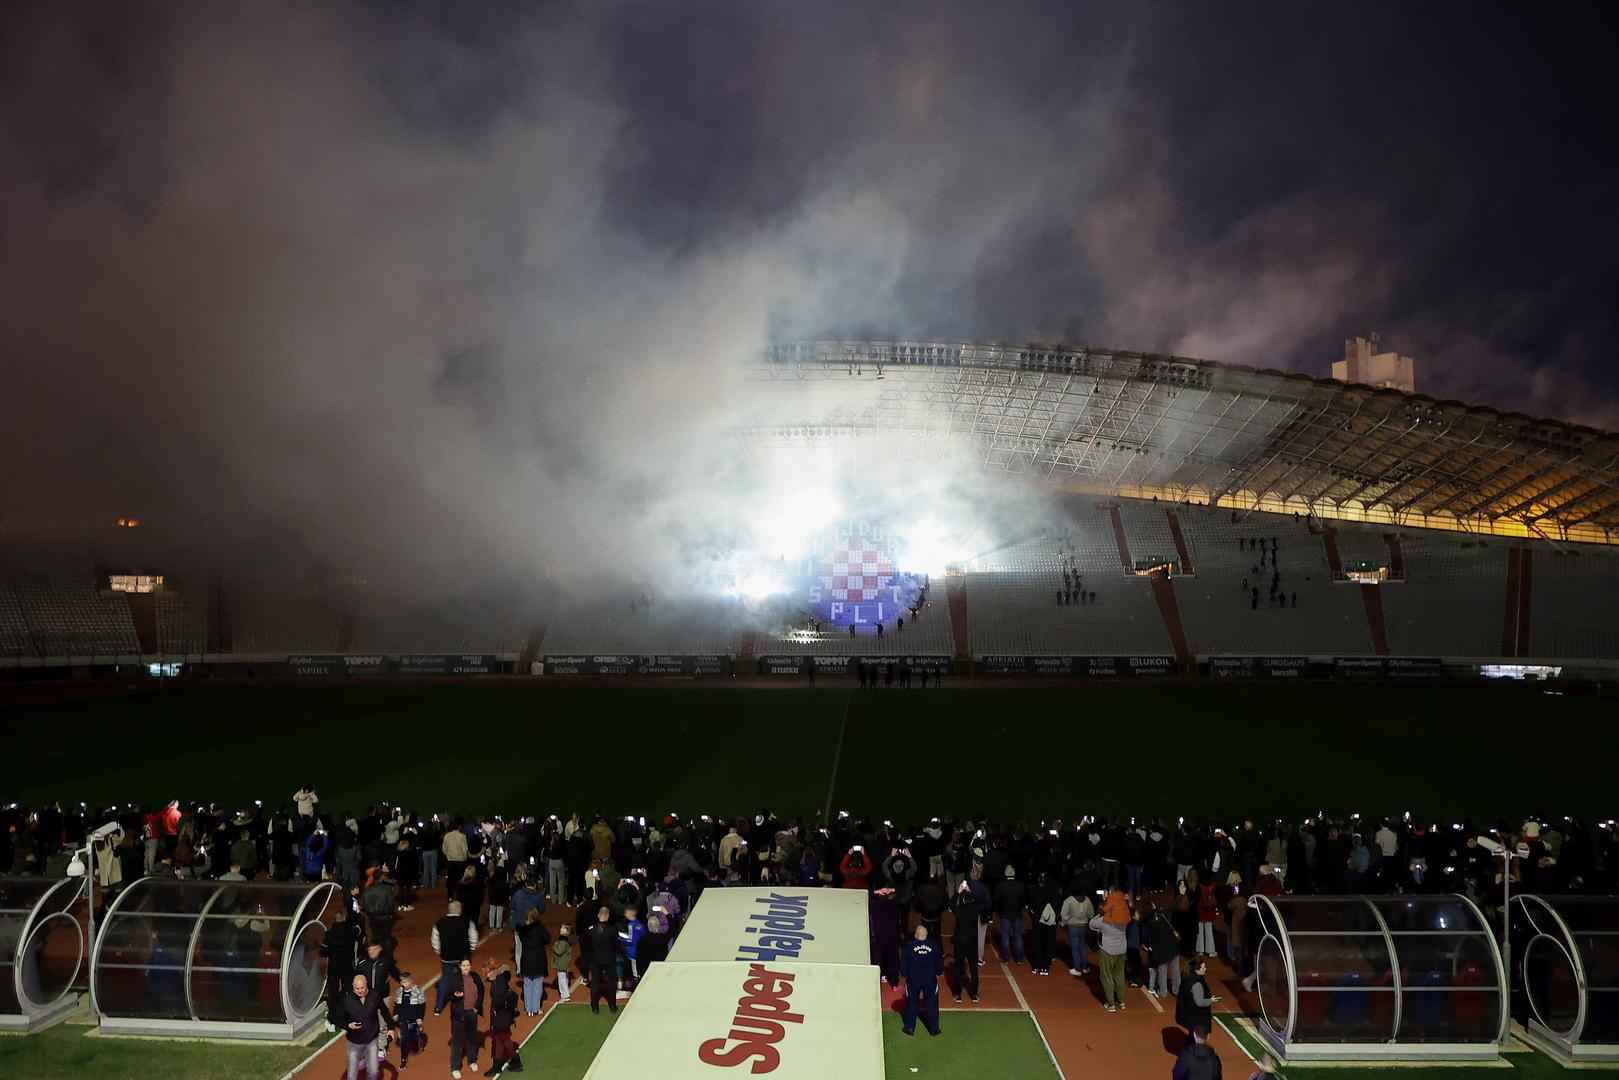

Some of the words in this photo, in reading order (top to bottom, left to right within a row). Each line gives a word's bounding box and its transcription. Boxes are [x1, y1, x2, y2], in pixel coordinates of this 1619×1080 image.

[809, 585, 901, 623] SPLIT
[344, 656, 383, 665] TOMMY
[813, 656, 850, 665] TOMMY
[1139, 658, 1170, 666] LUKOIL
[735, 892, 815, 962] Hajduk
[698, 963, 804, 1074] Super
